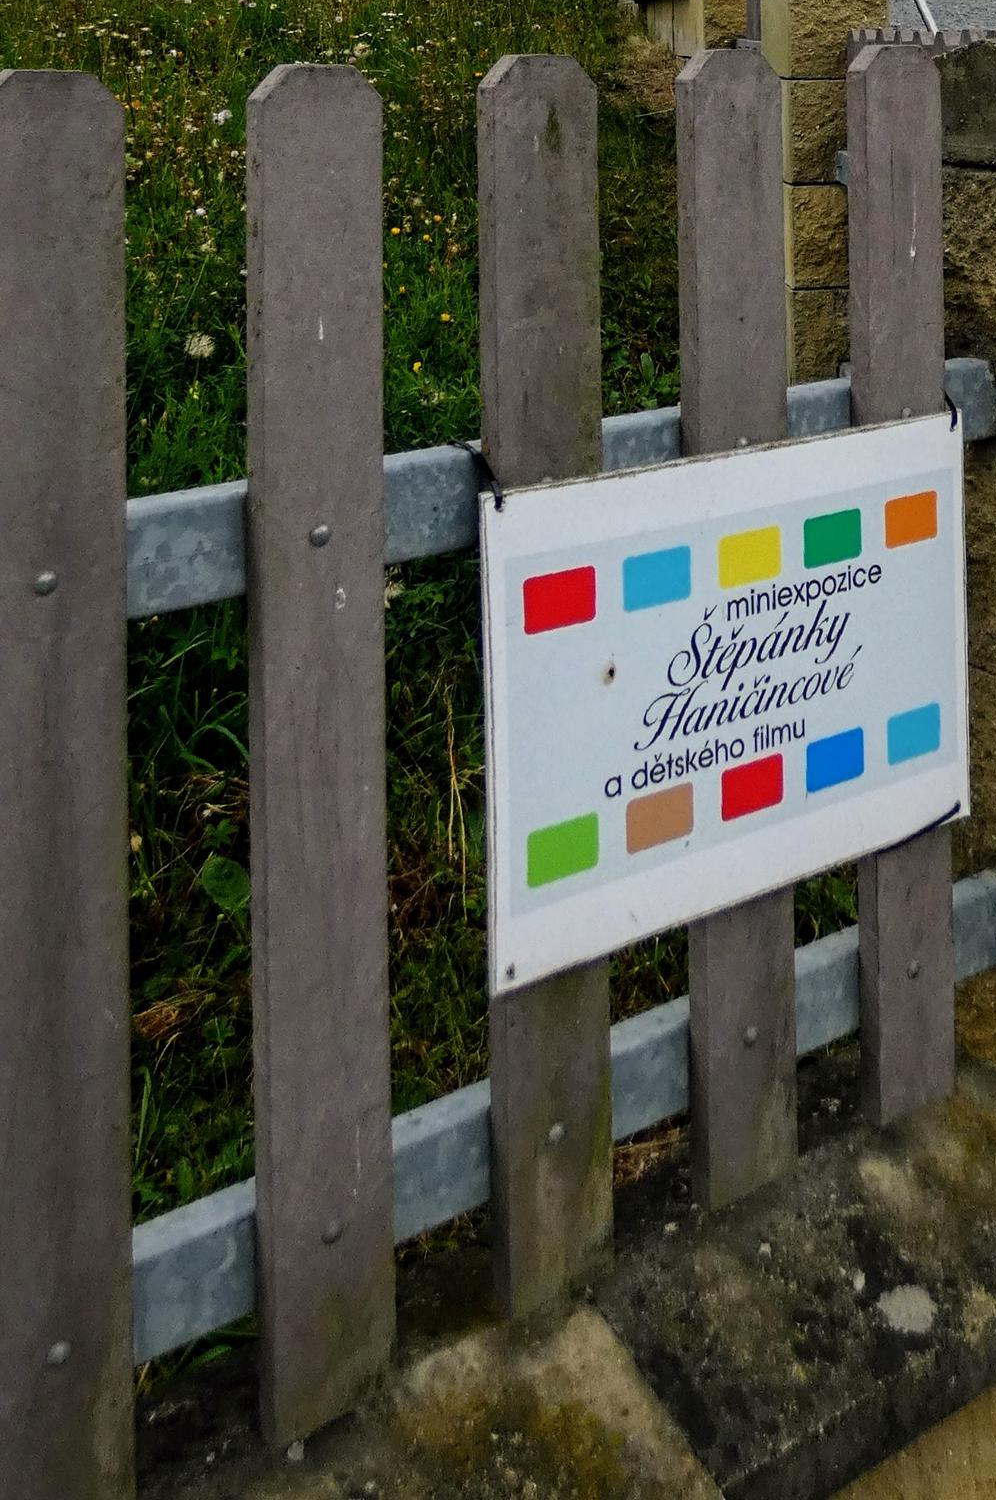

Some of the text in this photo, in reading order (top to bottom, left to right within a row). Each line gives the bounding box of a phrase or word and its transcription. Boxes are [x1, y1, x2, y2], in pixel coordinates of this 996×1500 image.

[726, 561, 883, 623] miniexpozice
[666, 599, 851, 691] Štěpánky
[634, 644, 864, 752] Haničincové
[604, 717, 807, 798] a dětského filmu
